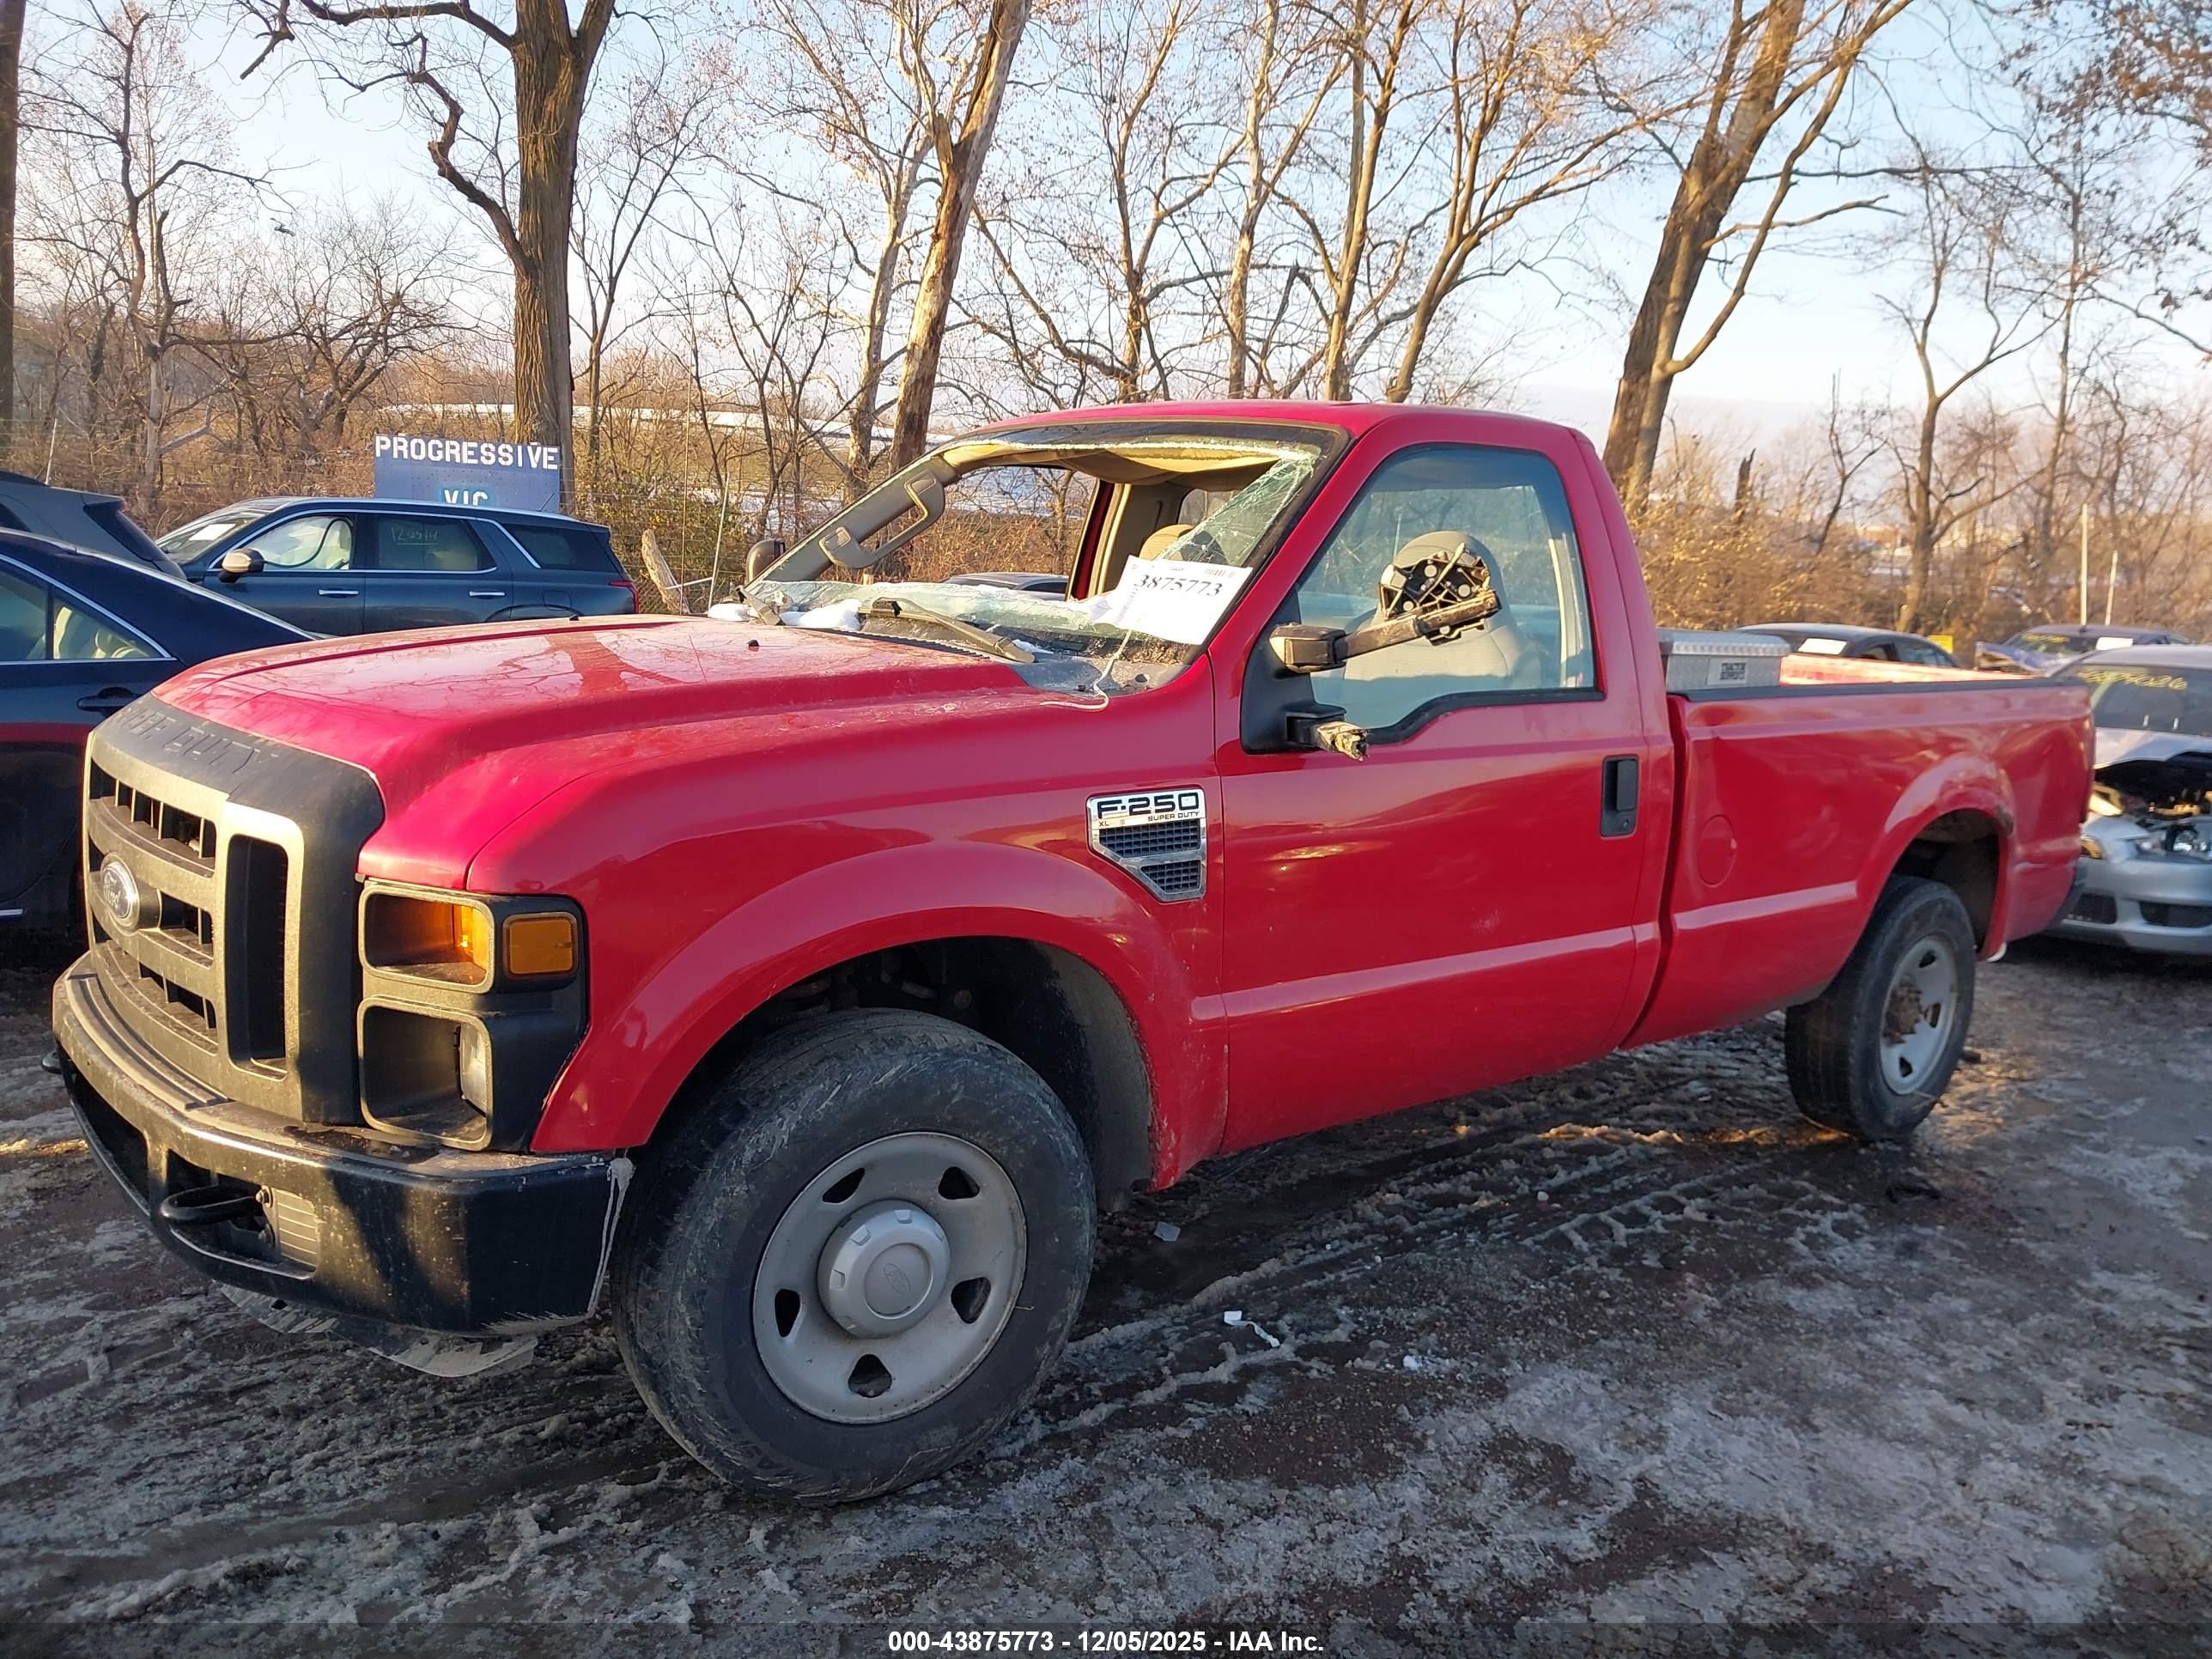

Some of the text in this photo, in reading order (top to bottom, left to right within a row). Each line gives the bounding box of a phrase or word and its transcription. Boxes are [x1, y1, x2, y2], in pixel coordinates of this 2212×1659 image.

[375, 435, 558, 470] PROGRESSIVE
[1133, 574, 1224, 596] 3875773
[1097, 792, 1200, 819] F-250
[1147, 812, 1176, 822] SUPER
